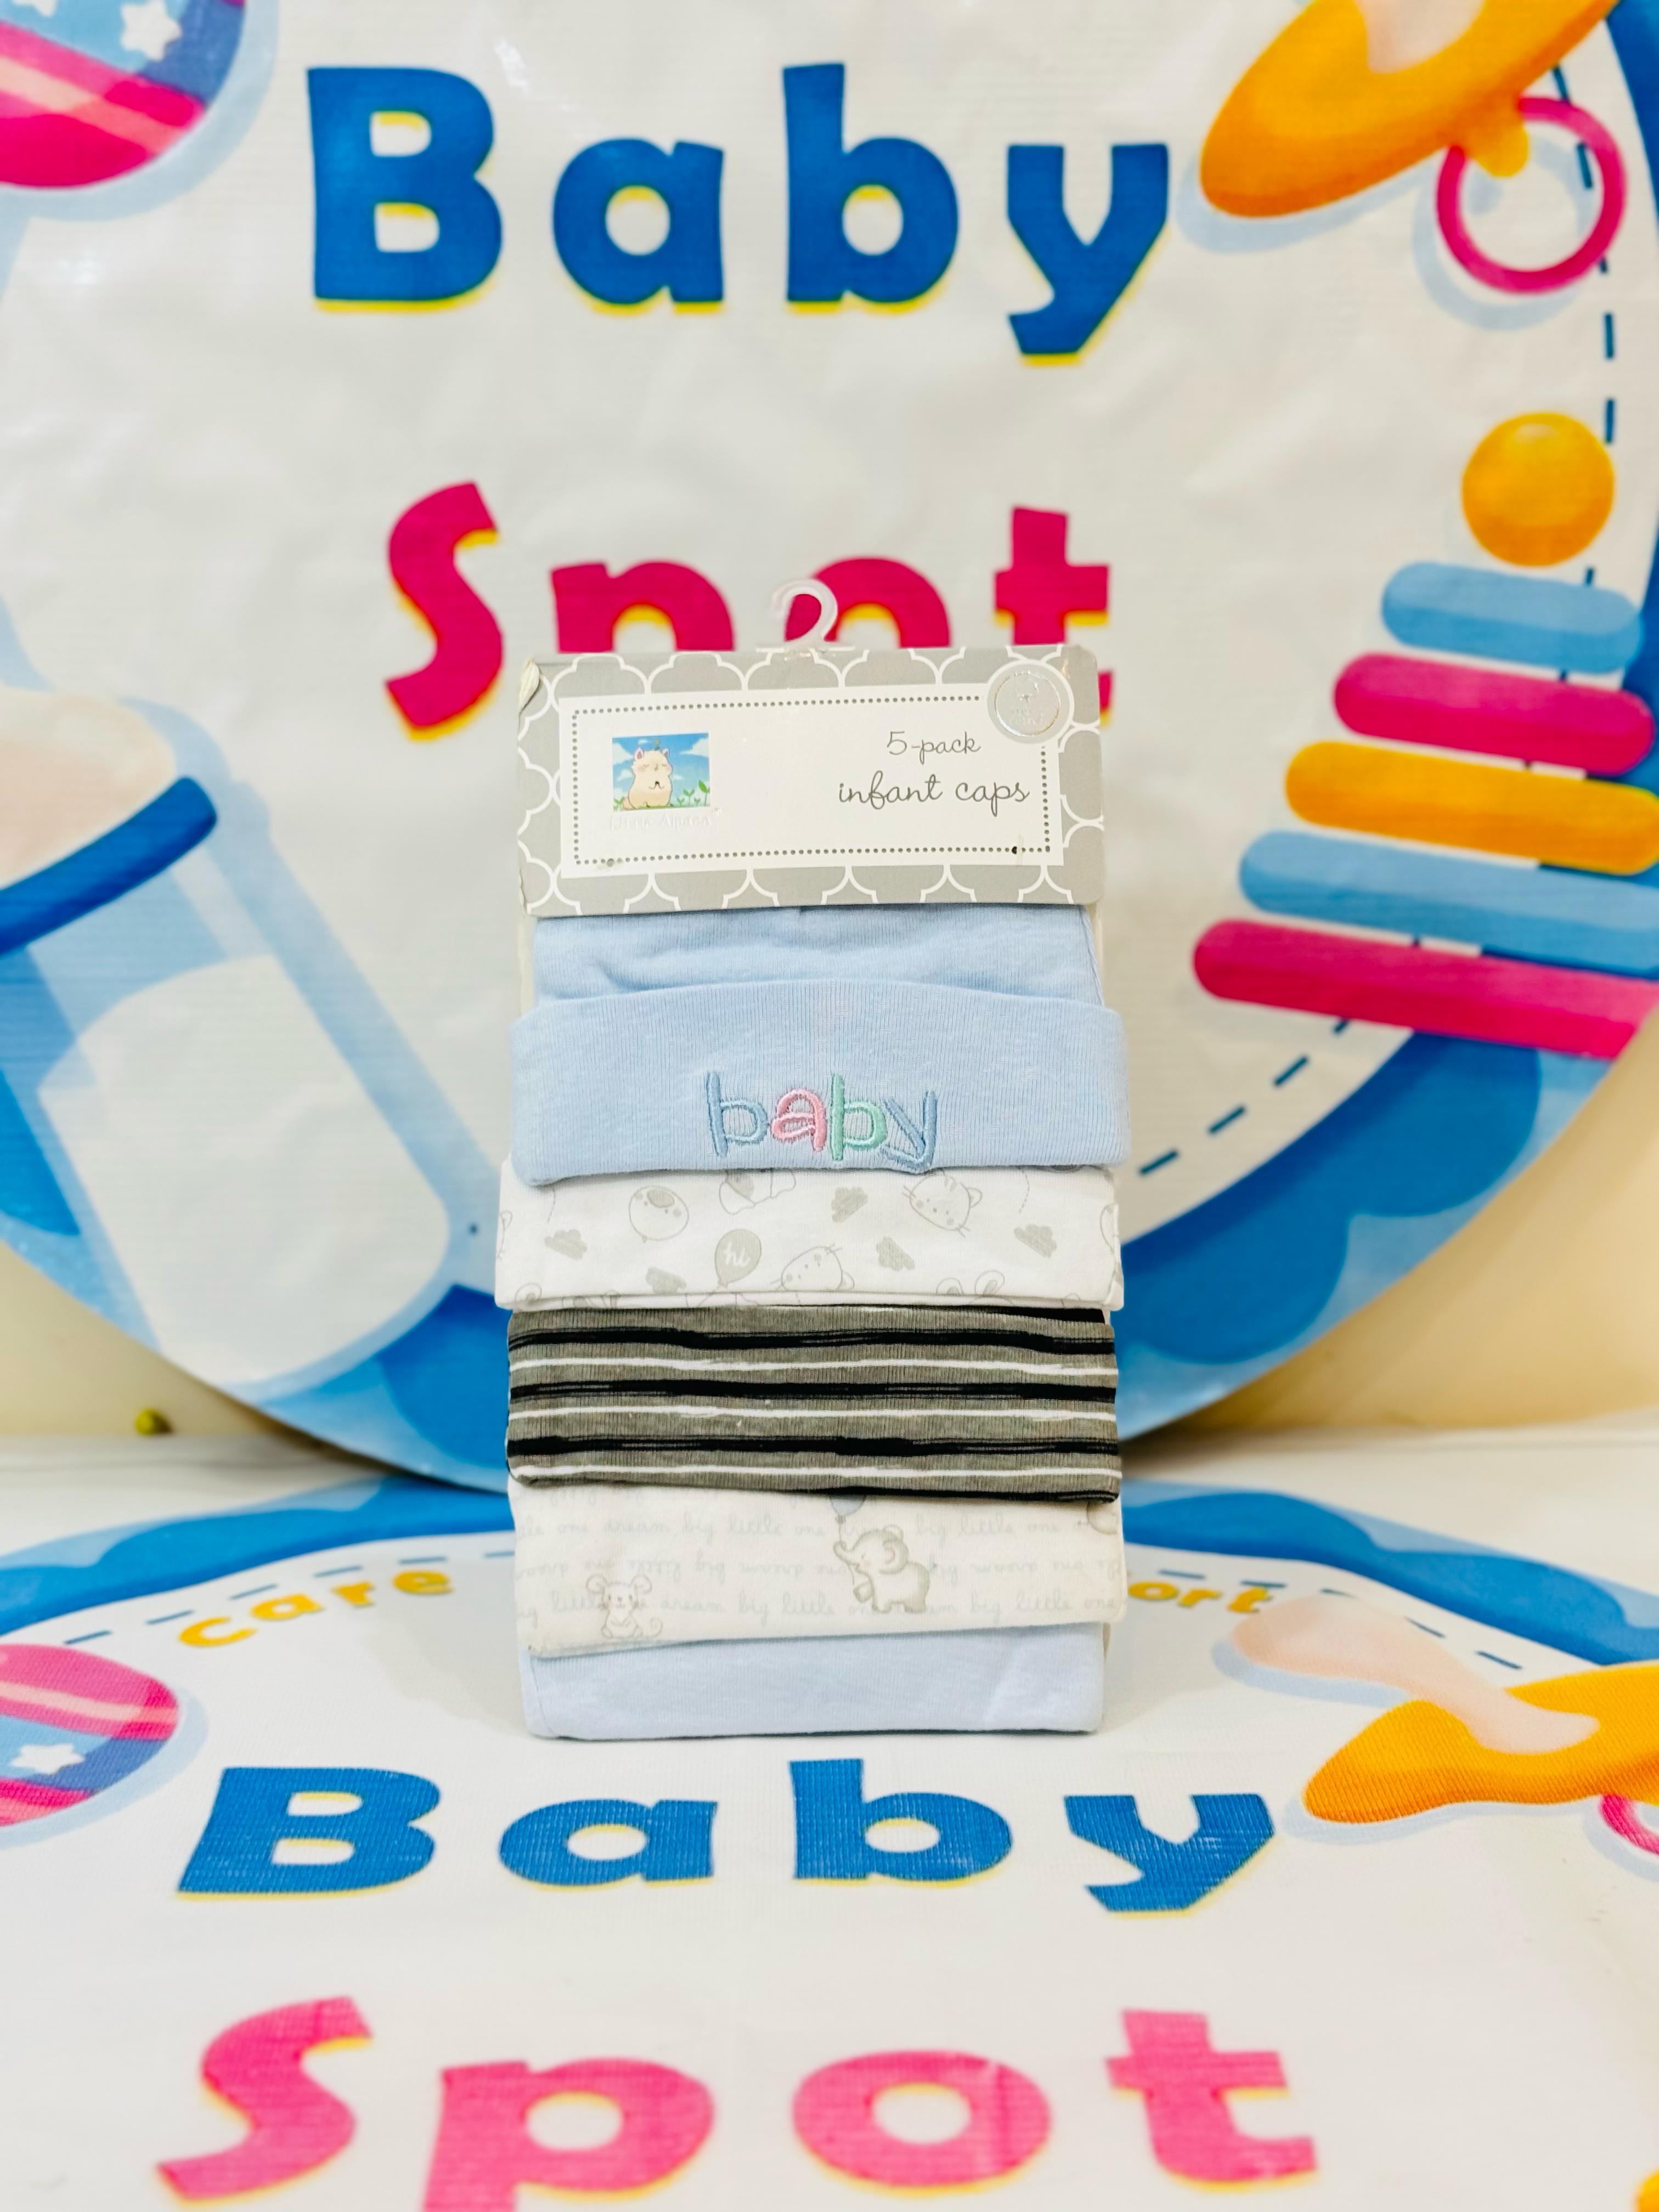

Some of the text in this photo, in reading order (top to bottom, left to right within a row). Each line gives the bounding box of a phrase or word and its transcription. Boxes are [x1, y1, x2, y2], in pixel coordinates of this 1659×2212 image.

[306, 63, 1169, 362] Baby
[839, 770, 1030, 817] infant caps
[887, 731, 981, 765] 5-pack
[706, 1071, 938, 1174] baby
[724, 1241, 751, 1267] hi
[177, 1758, 1277, 1914] Baby
[155, 1996, 1318, 2212] Spot
